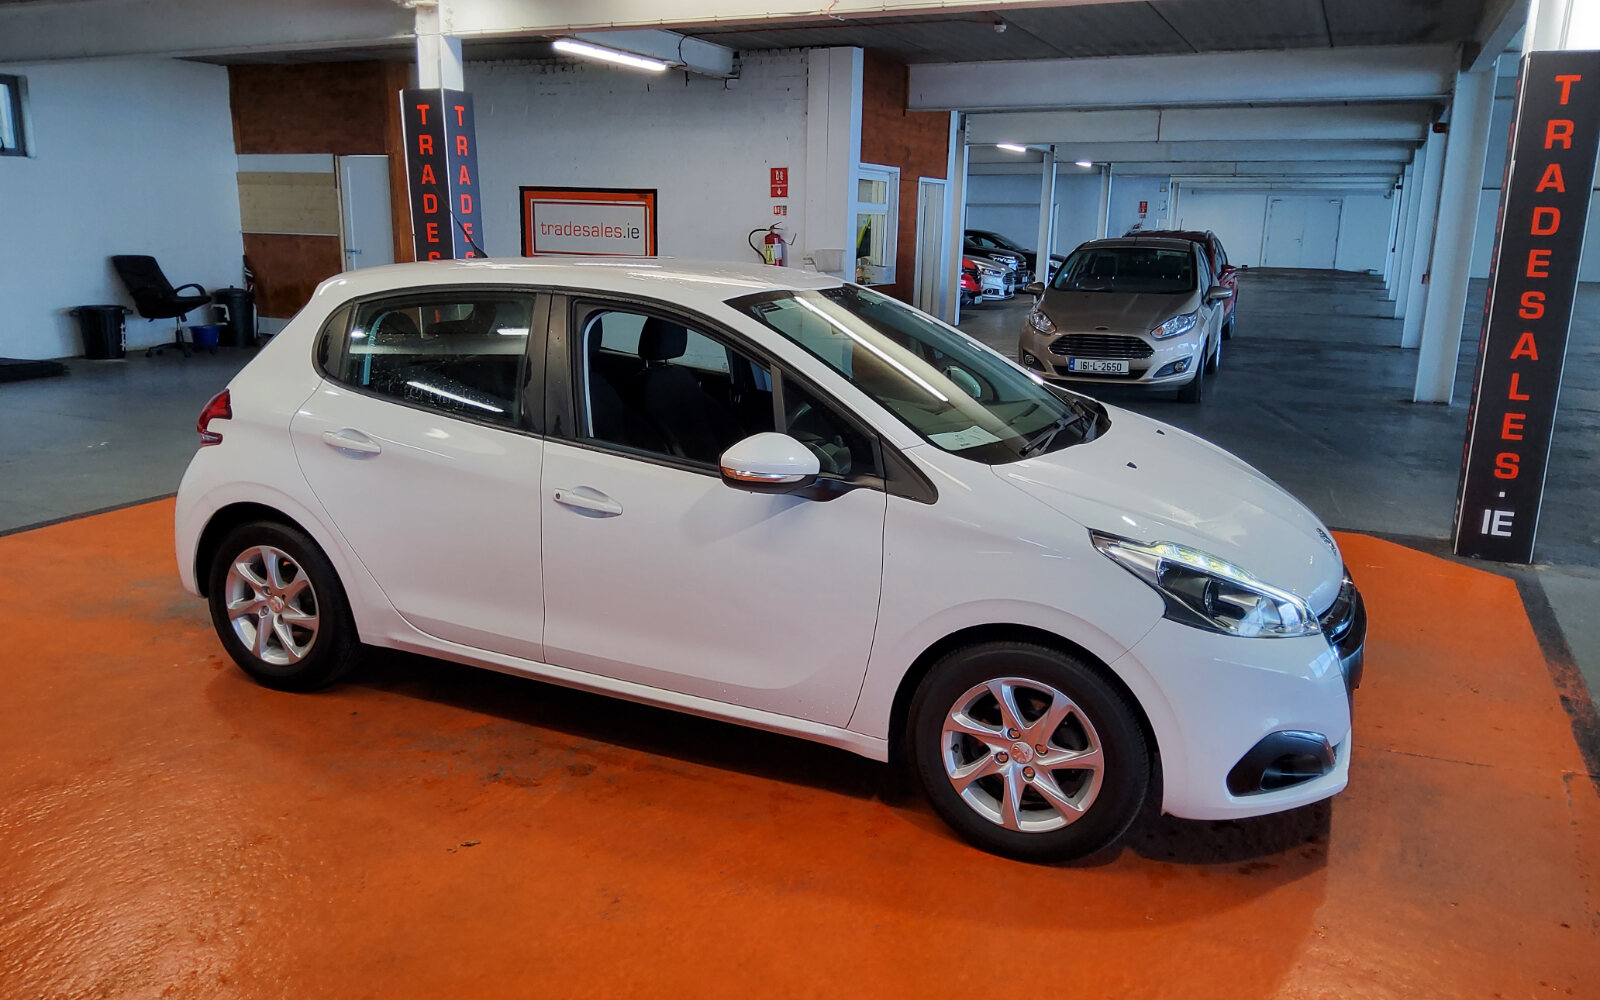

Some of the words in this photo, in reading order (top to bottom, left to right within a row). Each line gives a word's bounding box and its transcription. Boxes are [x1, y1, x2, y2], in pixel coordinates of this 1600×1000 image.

[540, 221, 640, 239] tradesales.ie
[1481, 75, 1581, 537] TRADESALES.IE
[1080, 361, 1122, 371] 161-L-2650
